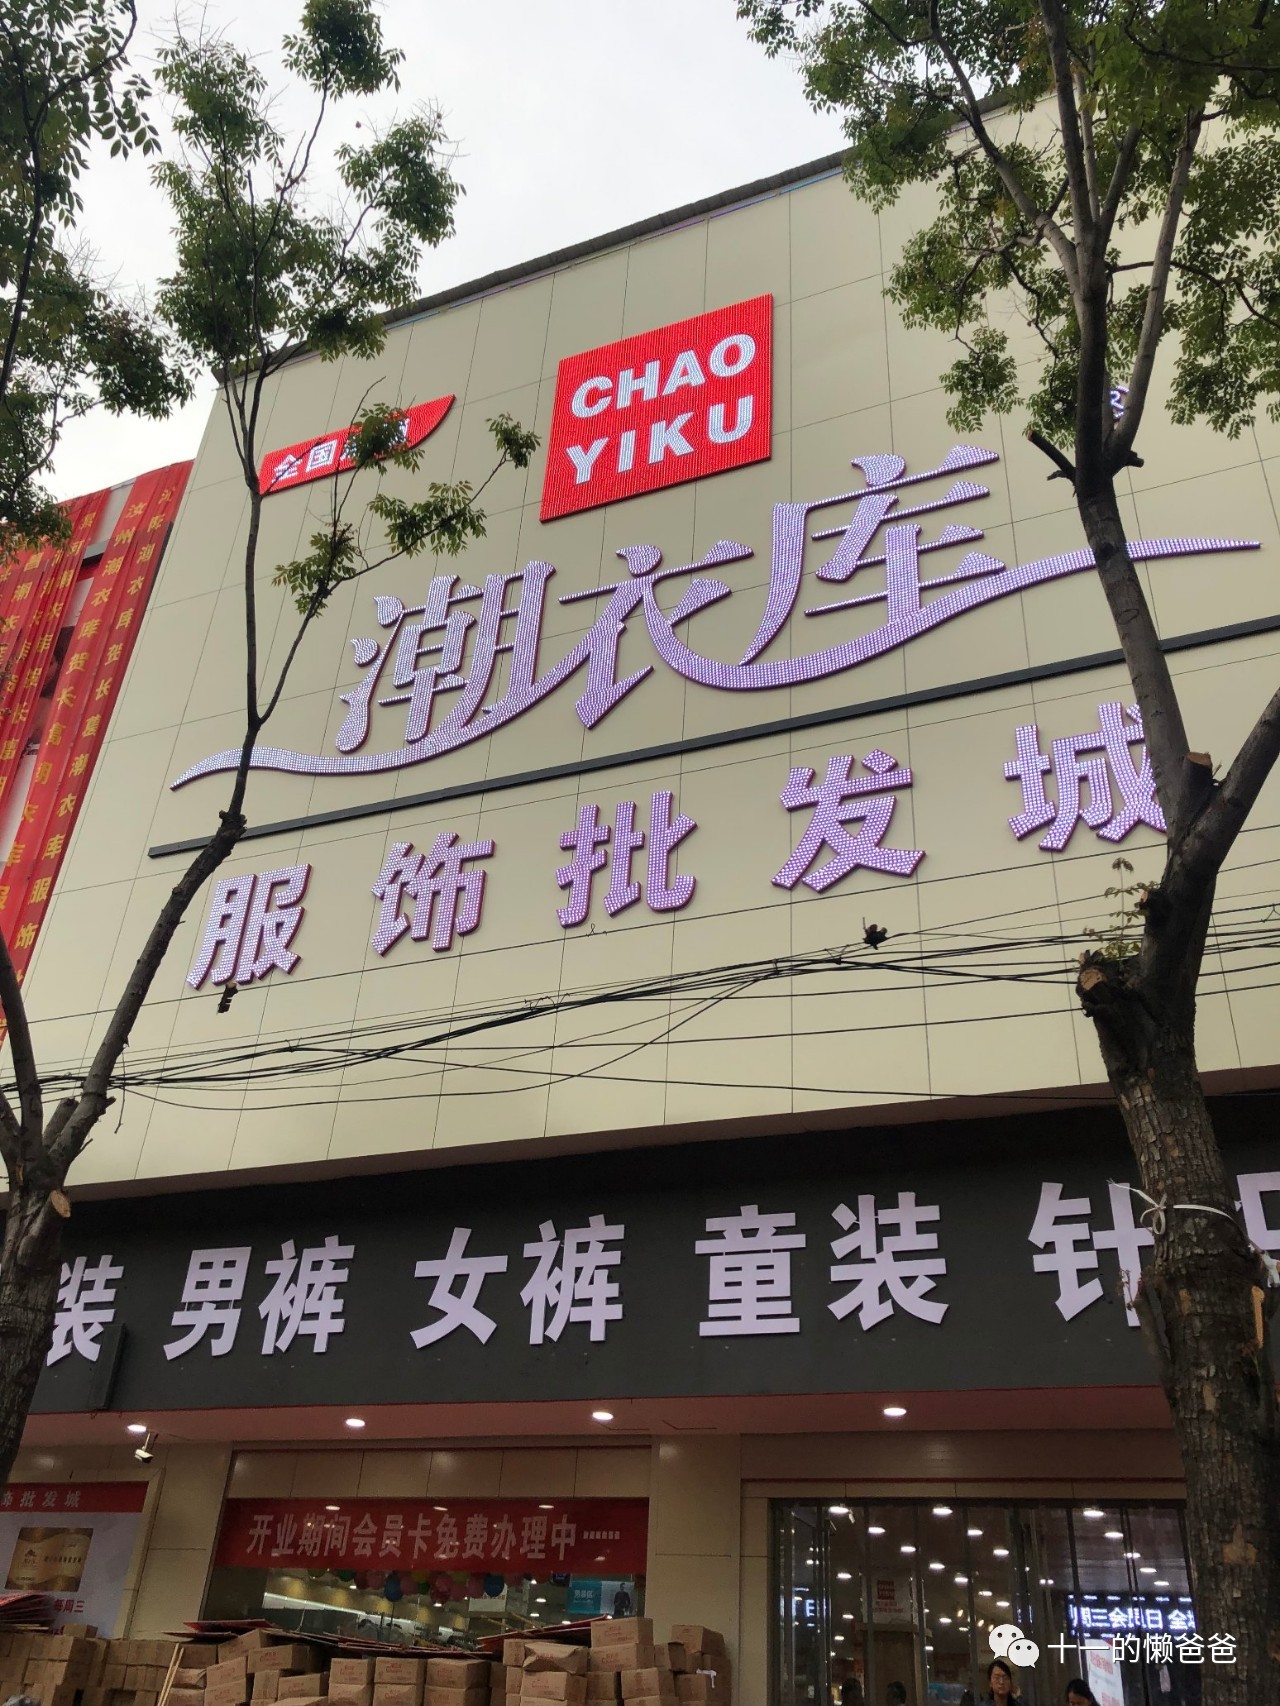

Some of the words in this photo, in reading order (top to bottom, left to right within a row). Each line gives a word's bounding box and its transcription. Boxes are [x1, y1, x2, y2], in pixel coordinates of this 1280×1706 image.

[565, 395, 754, 485] YIKU
[570, 333, 756, 418] CHAO
[172, 445, 1260, 791] 潮衣库
[187, 702, 1168, 990] 服饰批发城
[46, 1255, 124, 1367] 装
[163, 1235, 355, 1361] 男裤
[410, 1214, 625, 1349] 女裤
[695, 1191, 949, 1336] 童装
